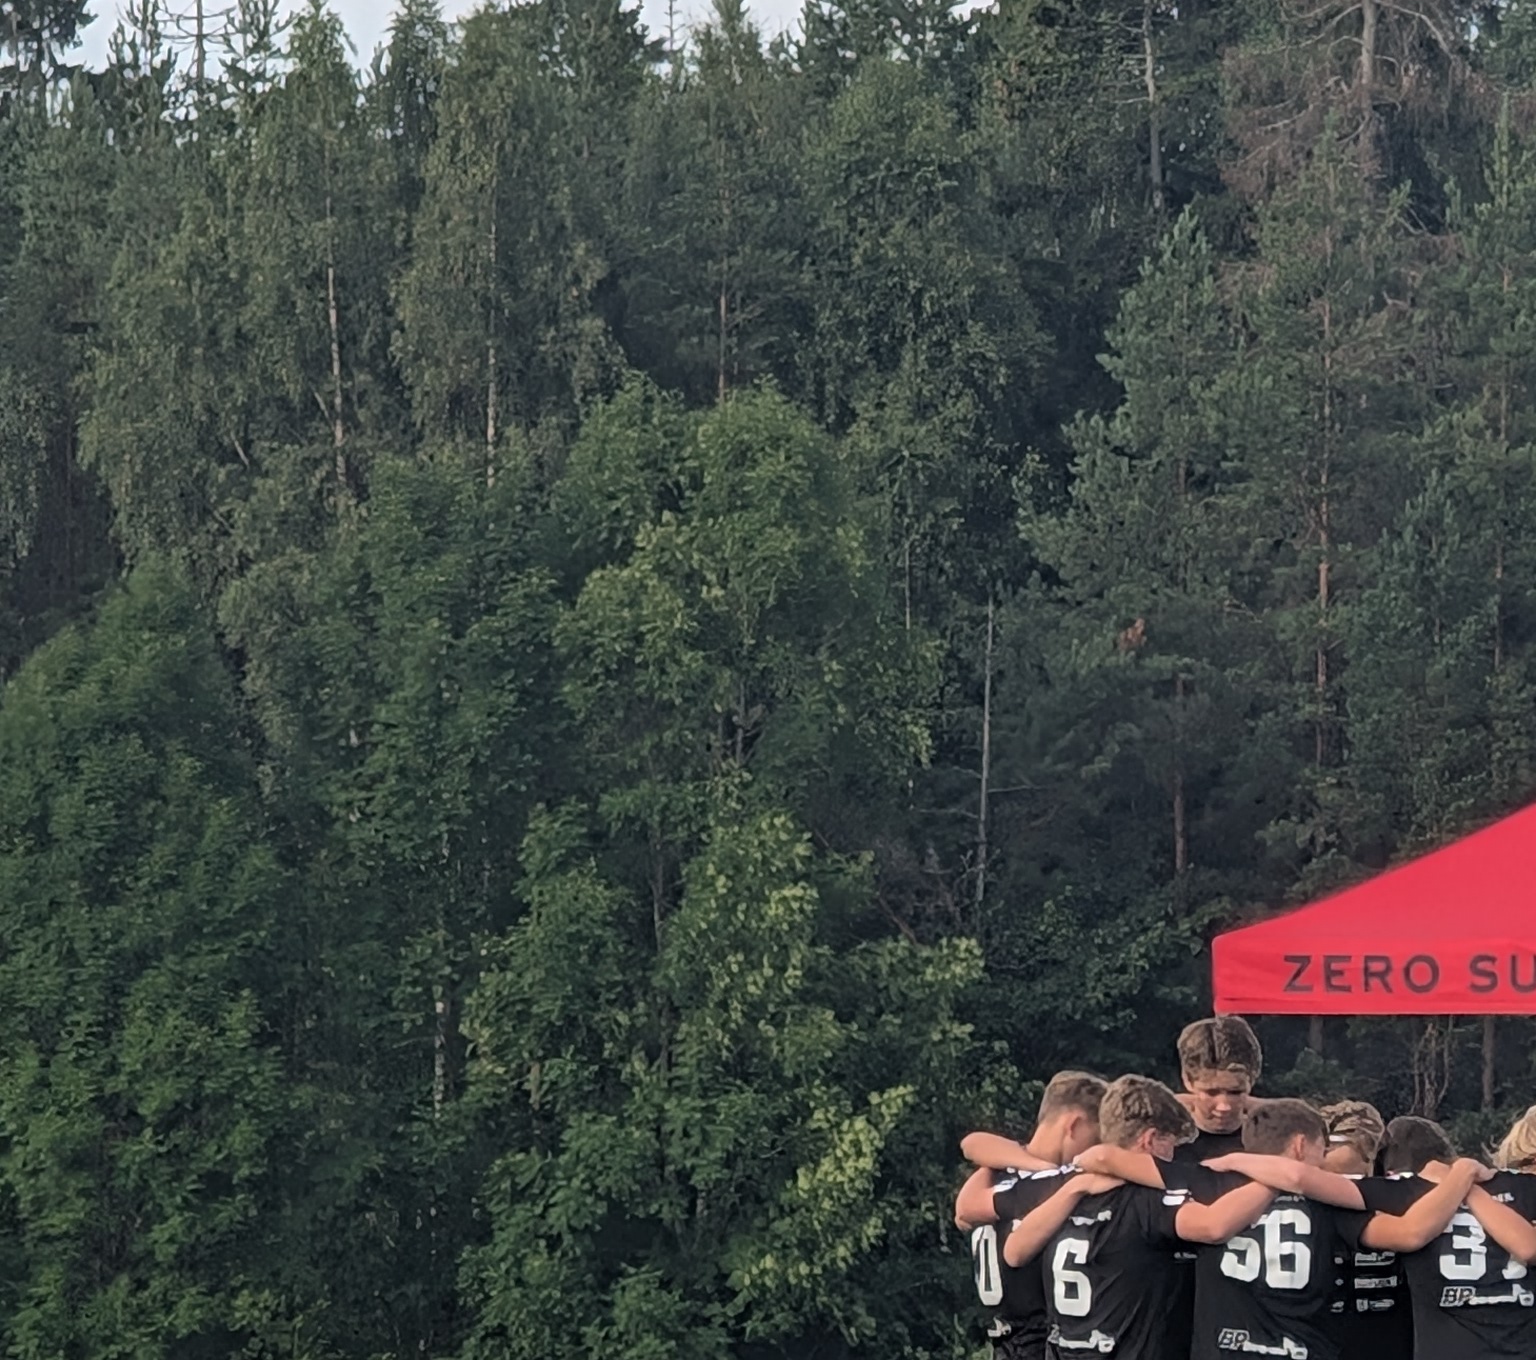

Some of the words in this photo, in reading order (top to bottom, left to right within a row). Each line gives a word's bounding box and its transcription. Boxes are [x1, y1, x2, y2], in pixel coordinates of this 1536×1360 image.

[1282, 953, 1441, 995] ZERO
[1052, 1237, 1092, 1317] 6
[1219, 1208, 1312, 1290] 56
